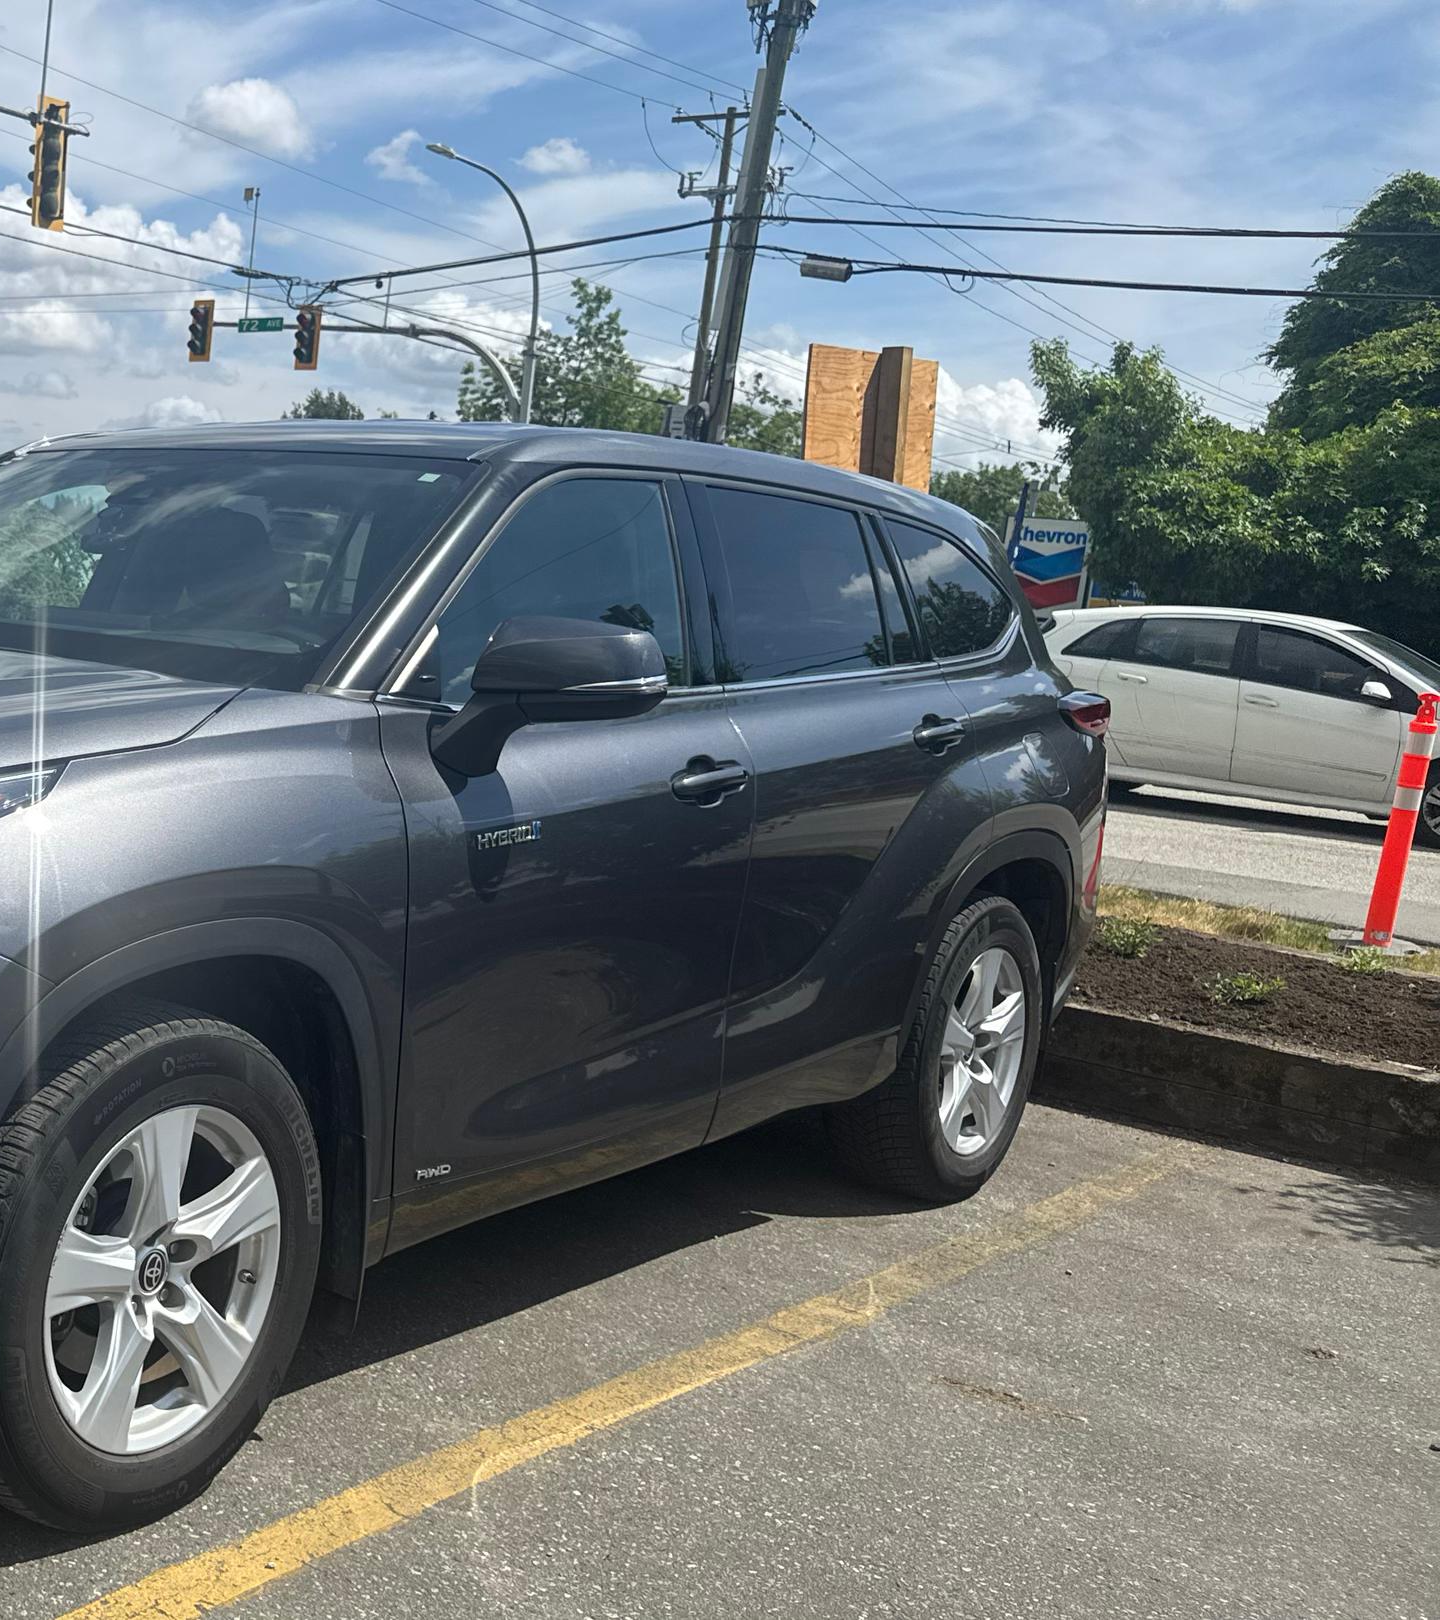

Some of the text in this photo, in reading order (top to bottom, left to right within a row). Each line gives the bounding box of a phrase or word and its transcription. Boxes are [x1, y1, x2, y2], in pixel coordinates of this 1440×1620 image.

[241, 319, 281, 331] 72 AVE
[1021, 526, 1088, 545] hevron
[476, 825, 532, 850] HYBRID
